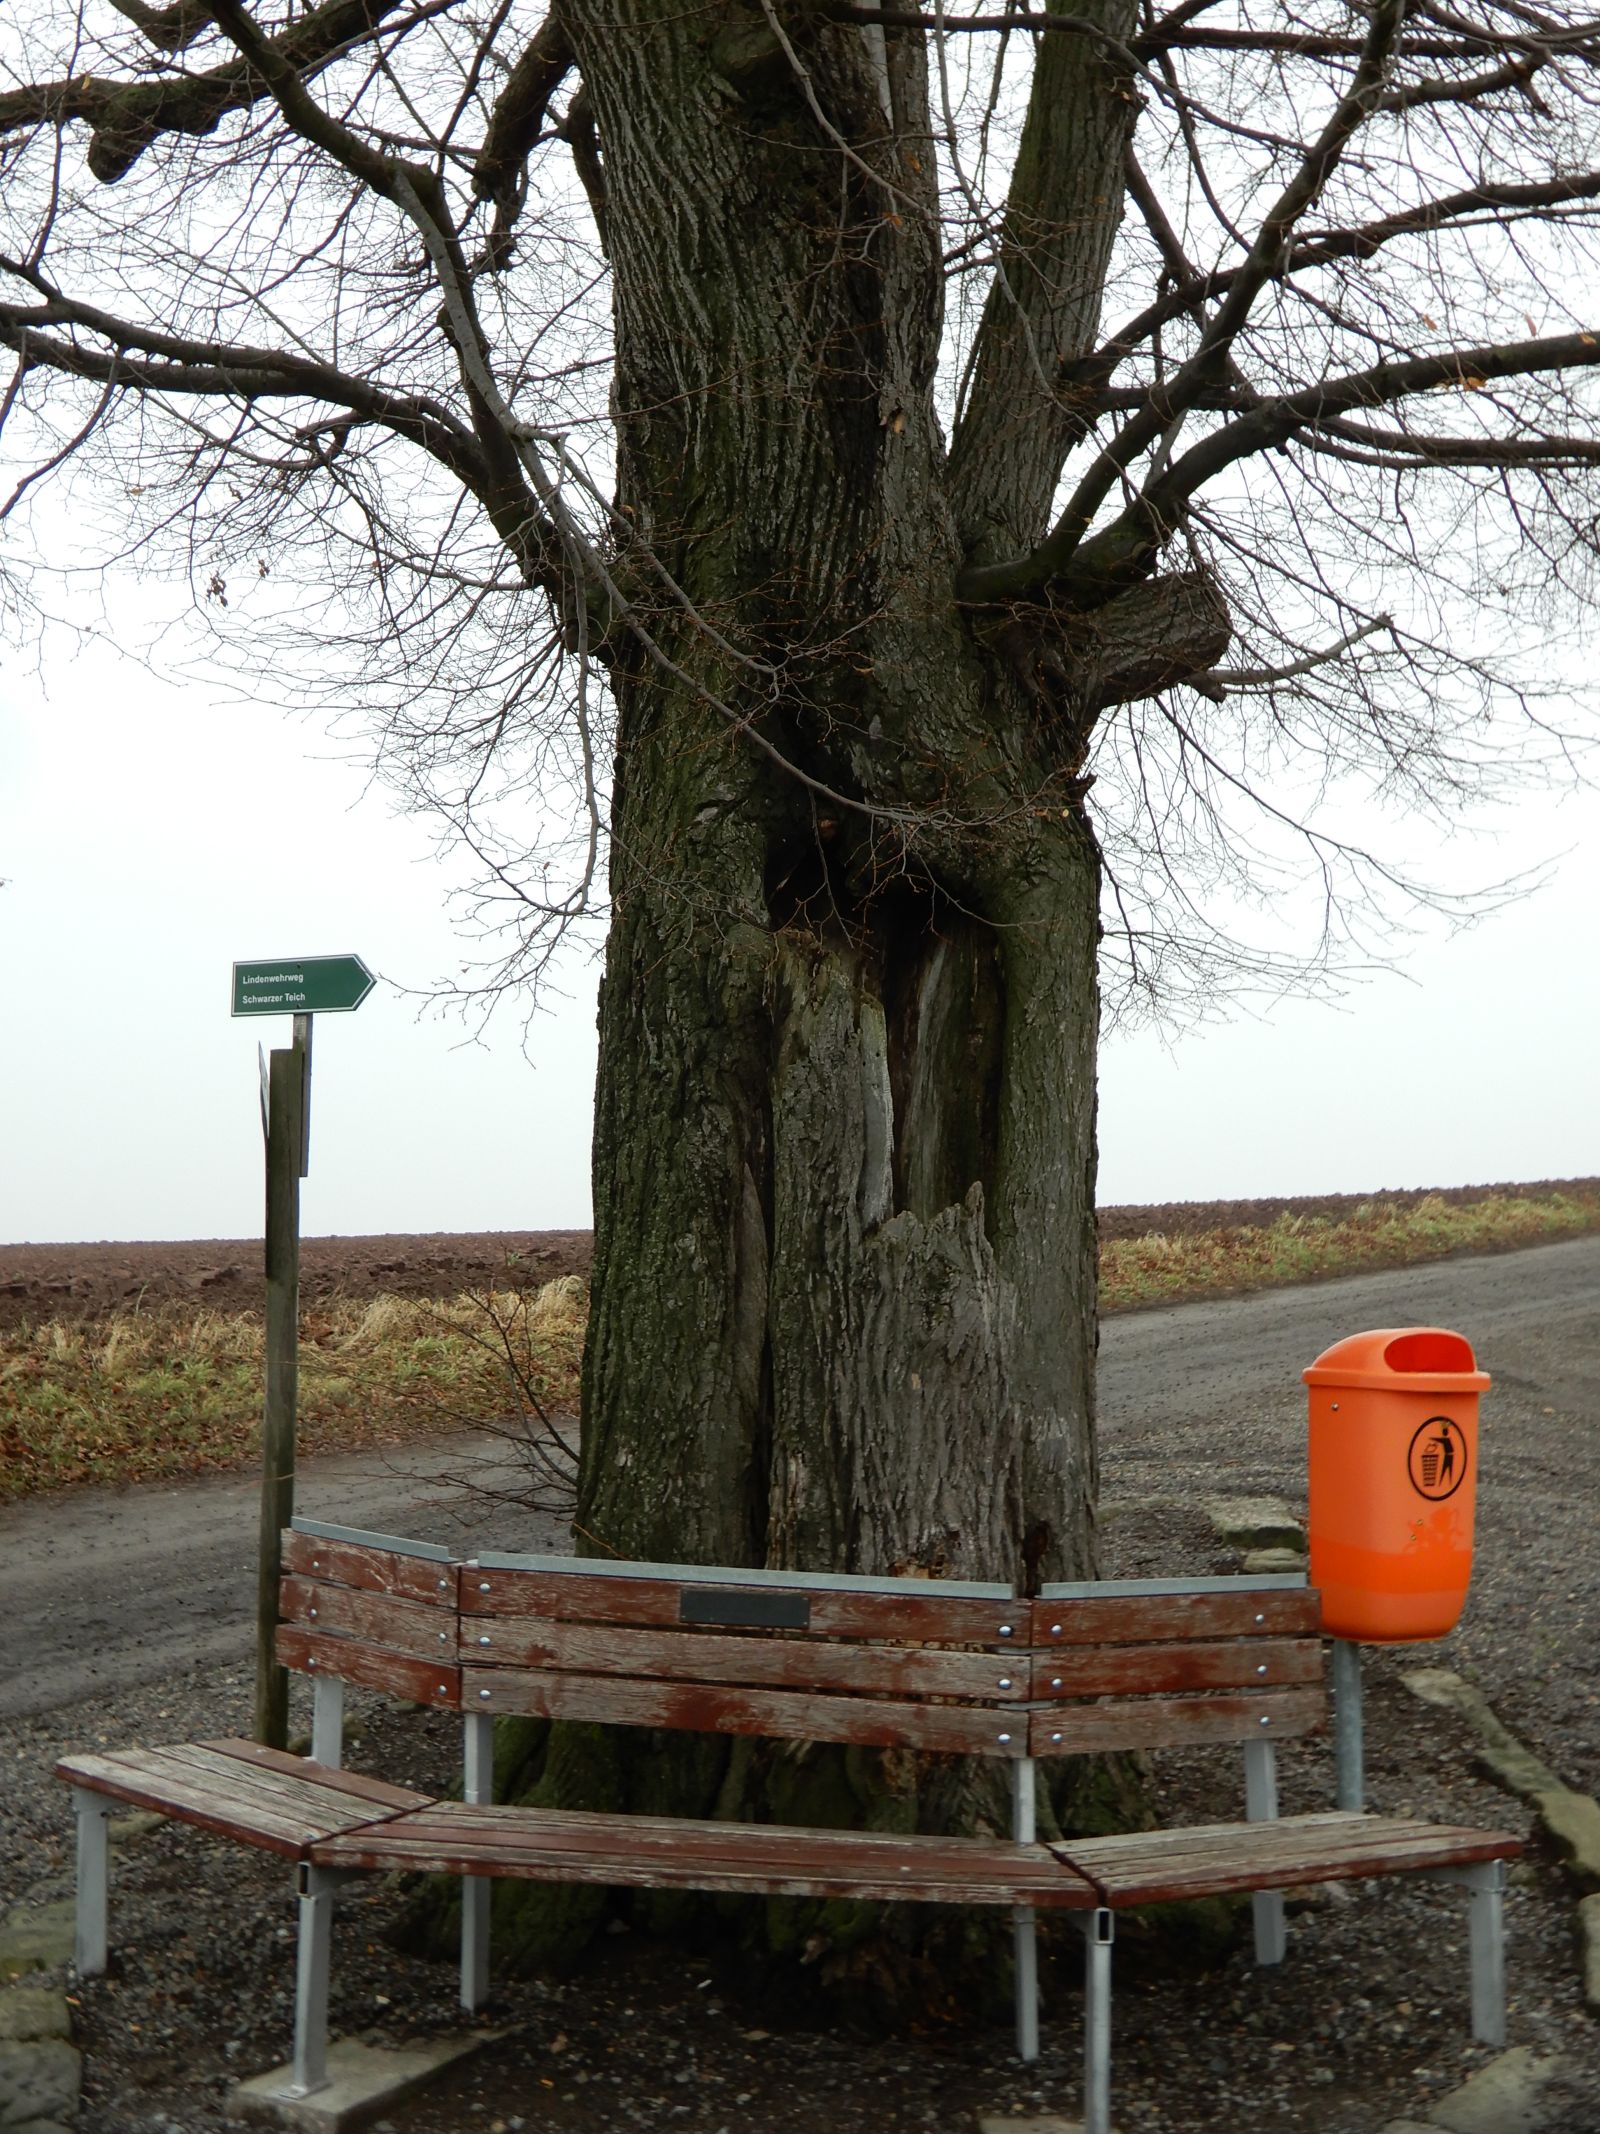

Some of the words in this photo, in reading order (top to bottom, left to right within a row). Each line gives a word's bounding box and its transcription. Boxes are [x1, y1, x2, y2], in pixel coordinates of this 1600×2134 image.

[242, 973, 304, 985] Lindenwehrweg
[242, 995, 283, 1004] Schwarzer
[285, 993, 306, 1001] Teich
